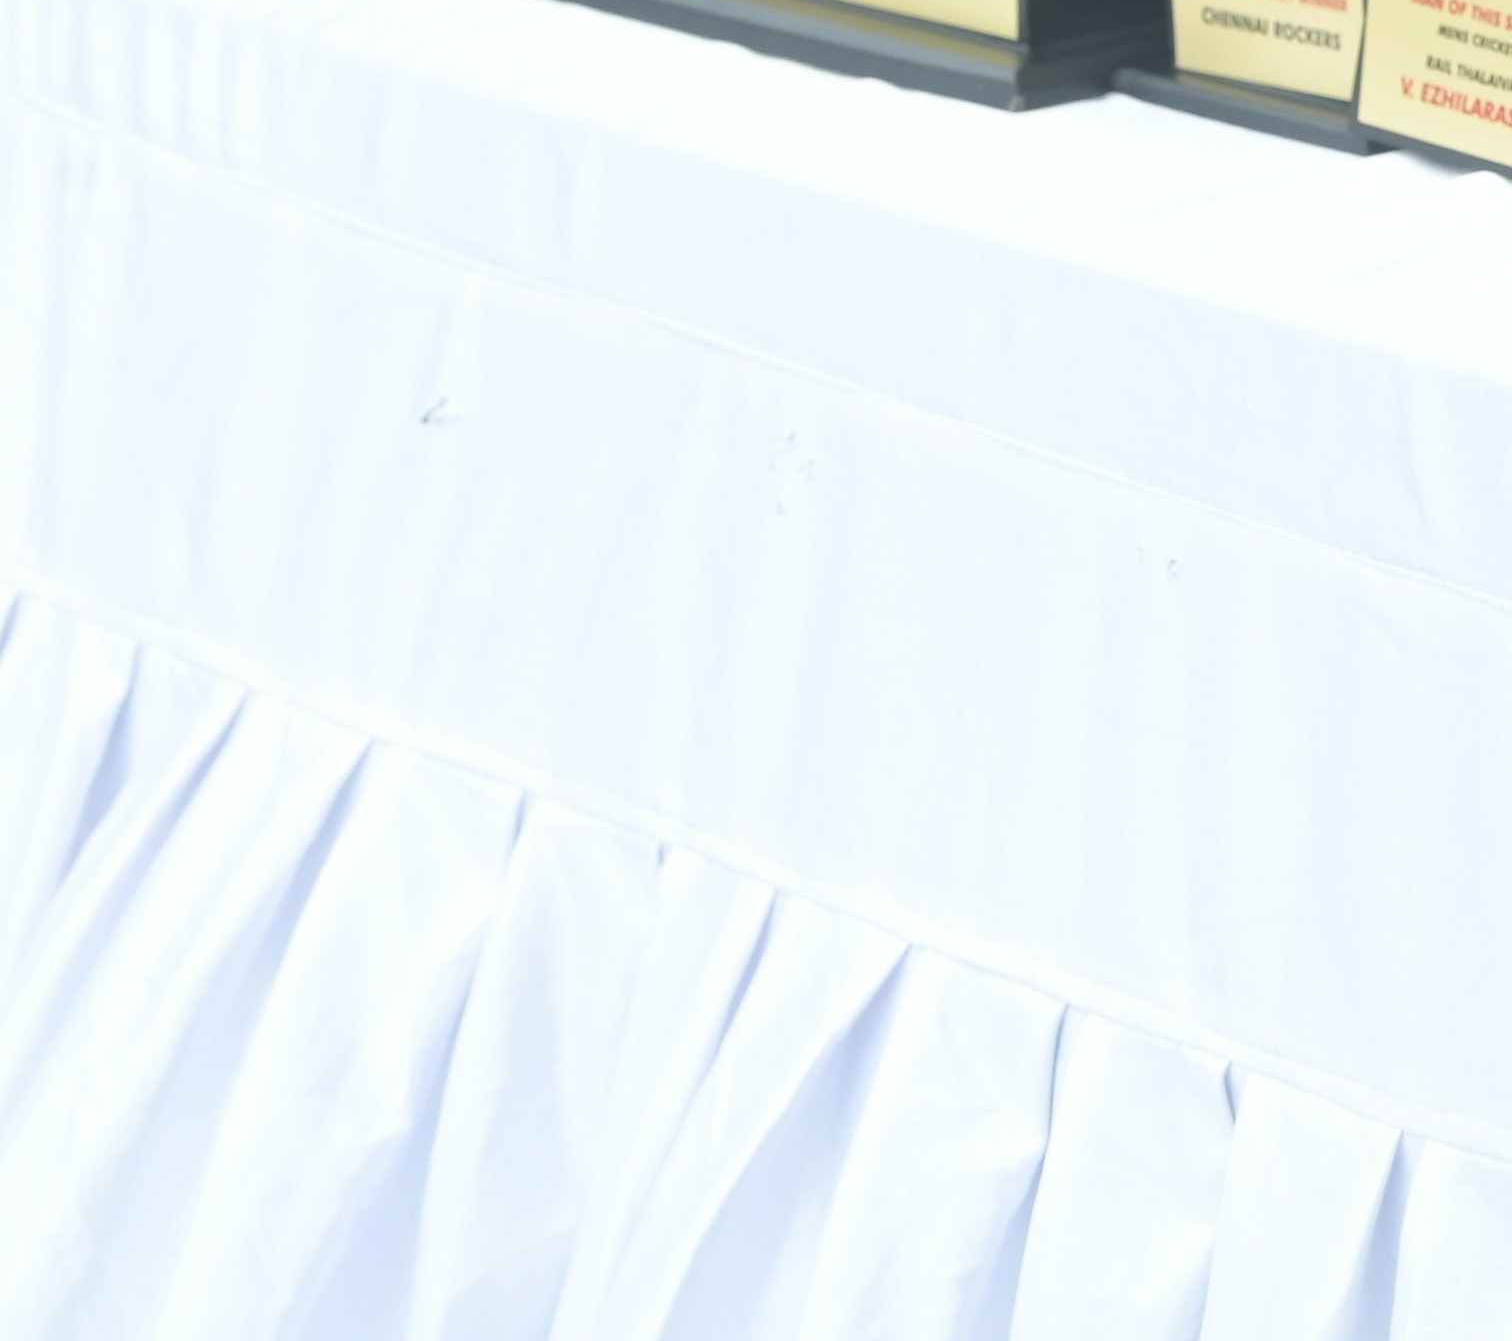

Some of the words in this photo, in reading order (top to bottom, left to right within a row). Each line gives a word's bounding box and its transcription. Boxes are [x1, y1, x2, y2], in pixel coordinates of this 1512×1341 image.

[1472, 2, 1500, 26] THIS
[1200, 6, 1268, 37] CHENNAI
[1273, 19, 1341, 51] ROCKERS
[1438, 24, 1469, 44] MENS
[1426, 55, 1453, 79] RAIL
[1401, 77, 1415, 99] V.
